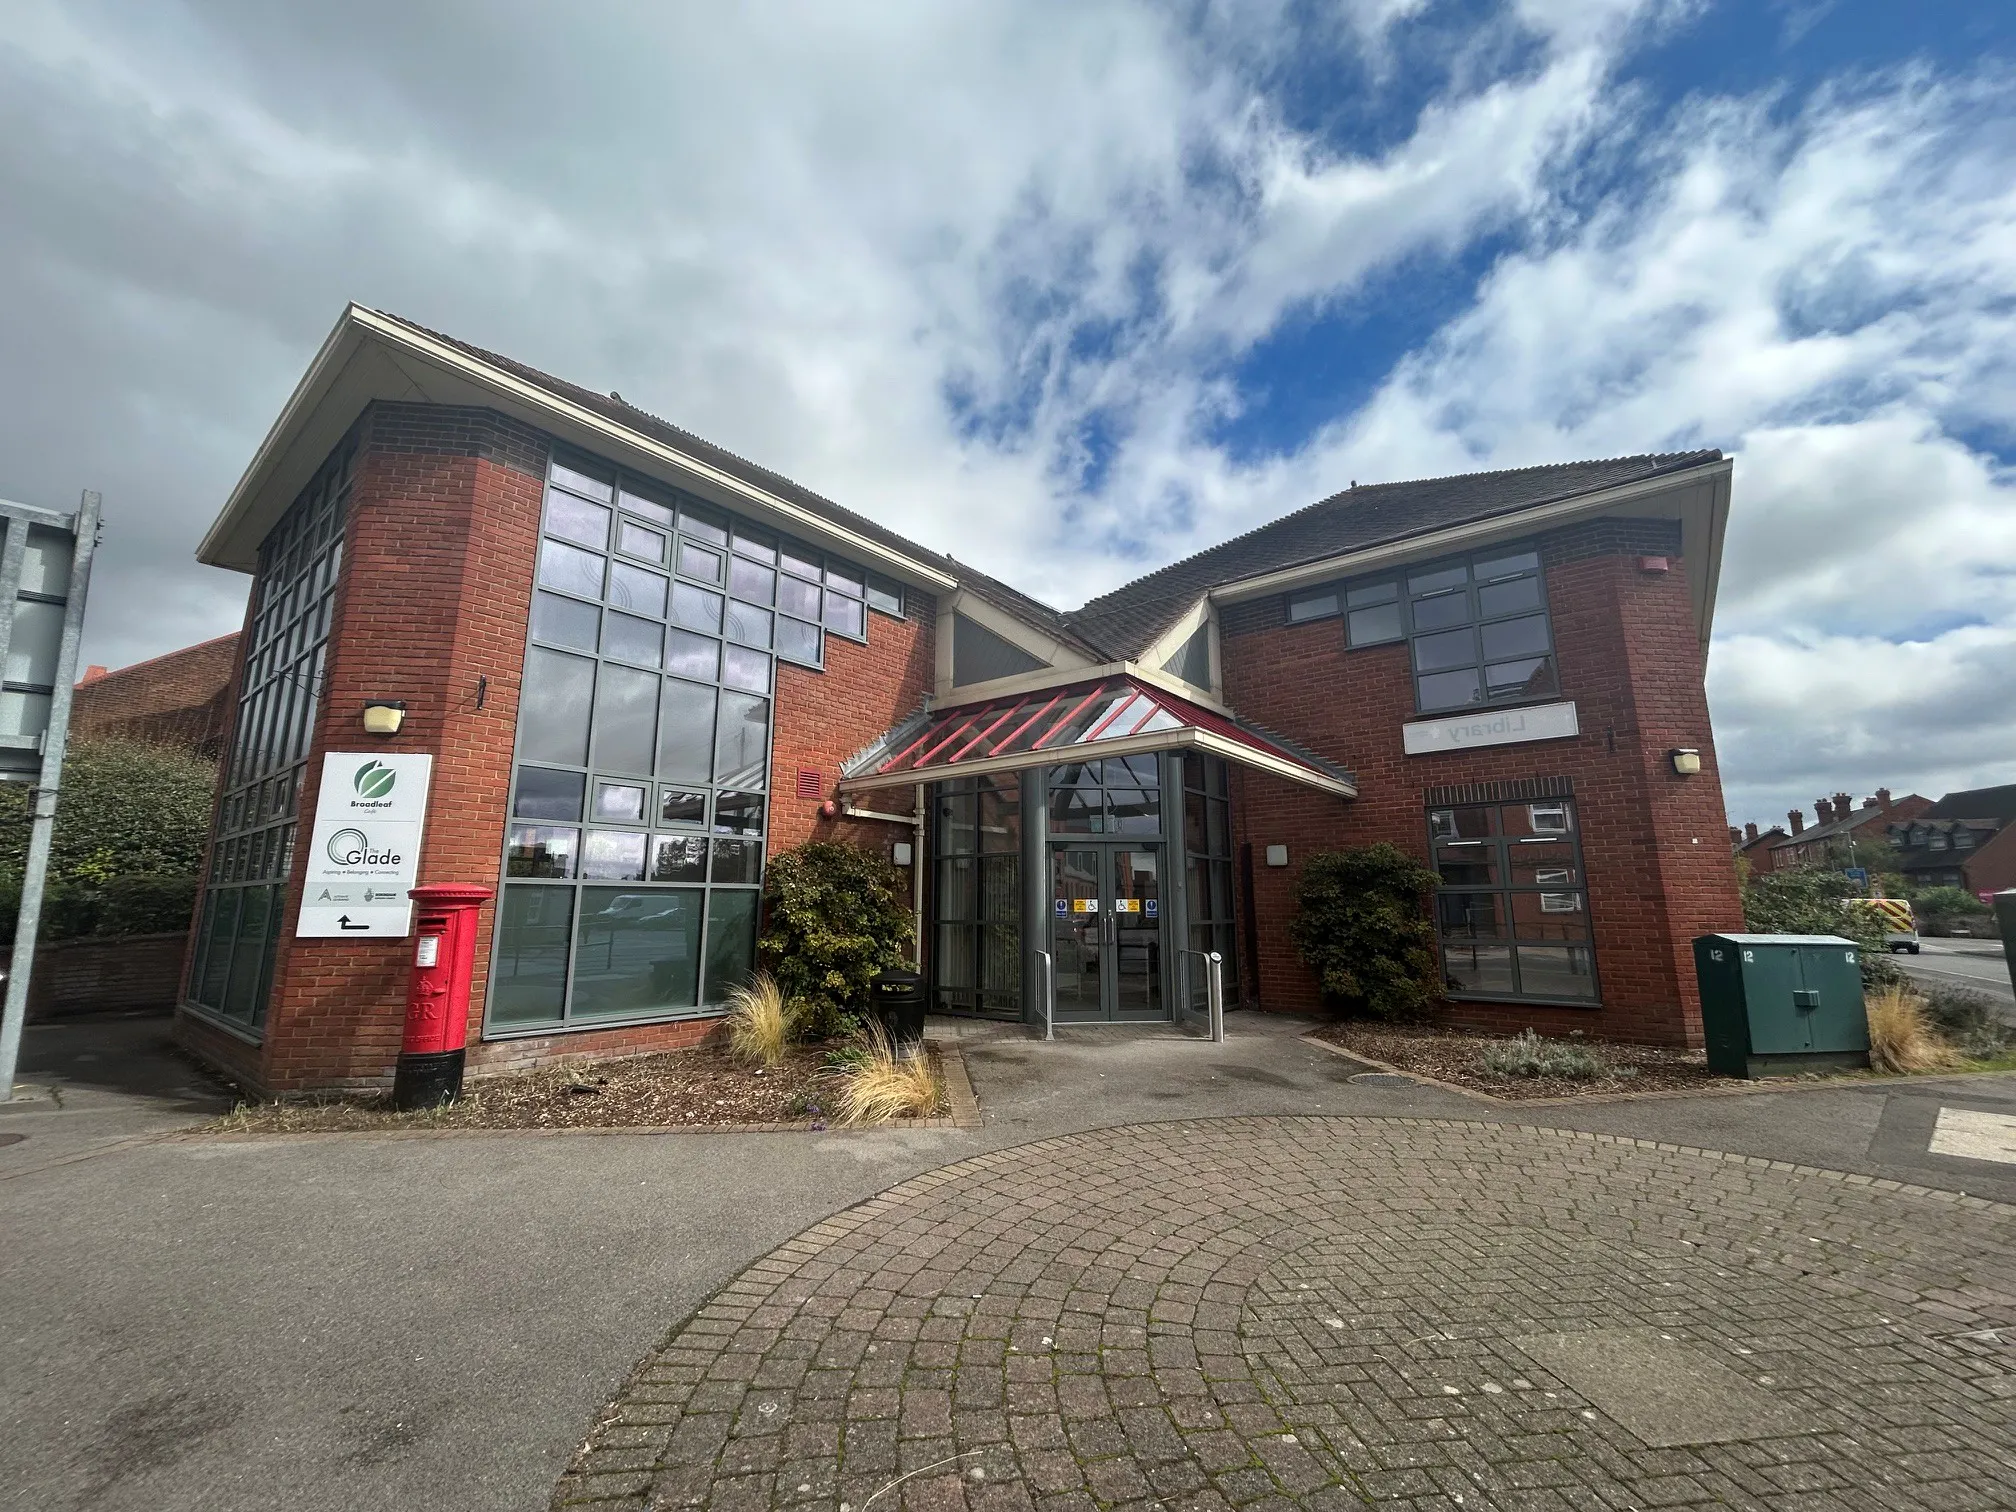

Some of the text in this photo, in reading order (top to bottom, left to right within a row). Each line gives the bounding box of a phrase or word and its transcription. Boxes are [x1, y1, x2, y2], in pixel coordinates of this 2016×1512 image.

[346, 849, 401, 864] Glade
[1710, 950, 1724, 962] 12
[1743, 950, 1754, 963] 12
[1845, 951, 1855, 963] 12
[407, 1002, 439, 1019] GR
